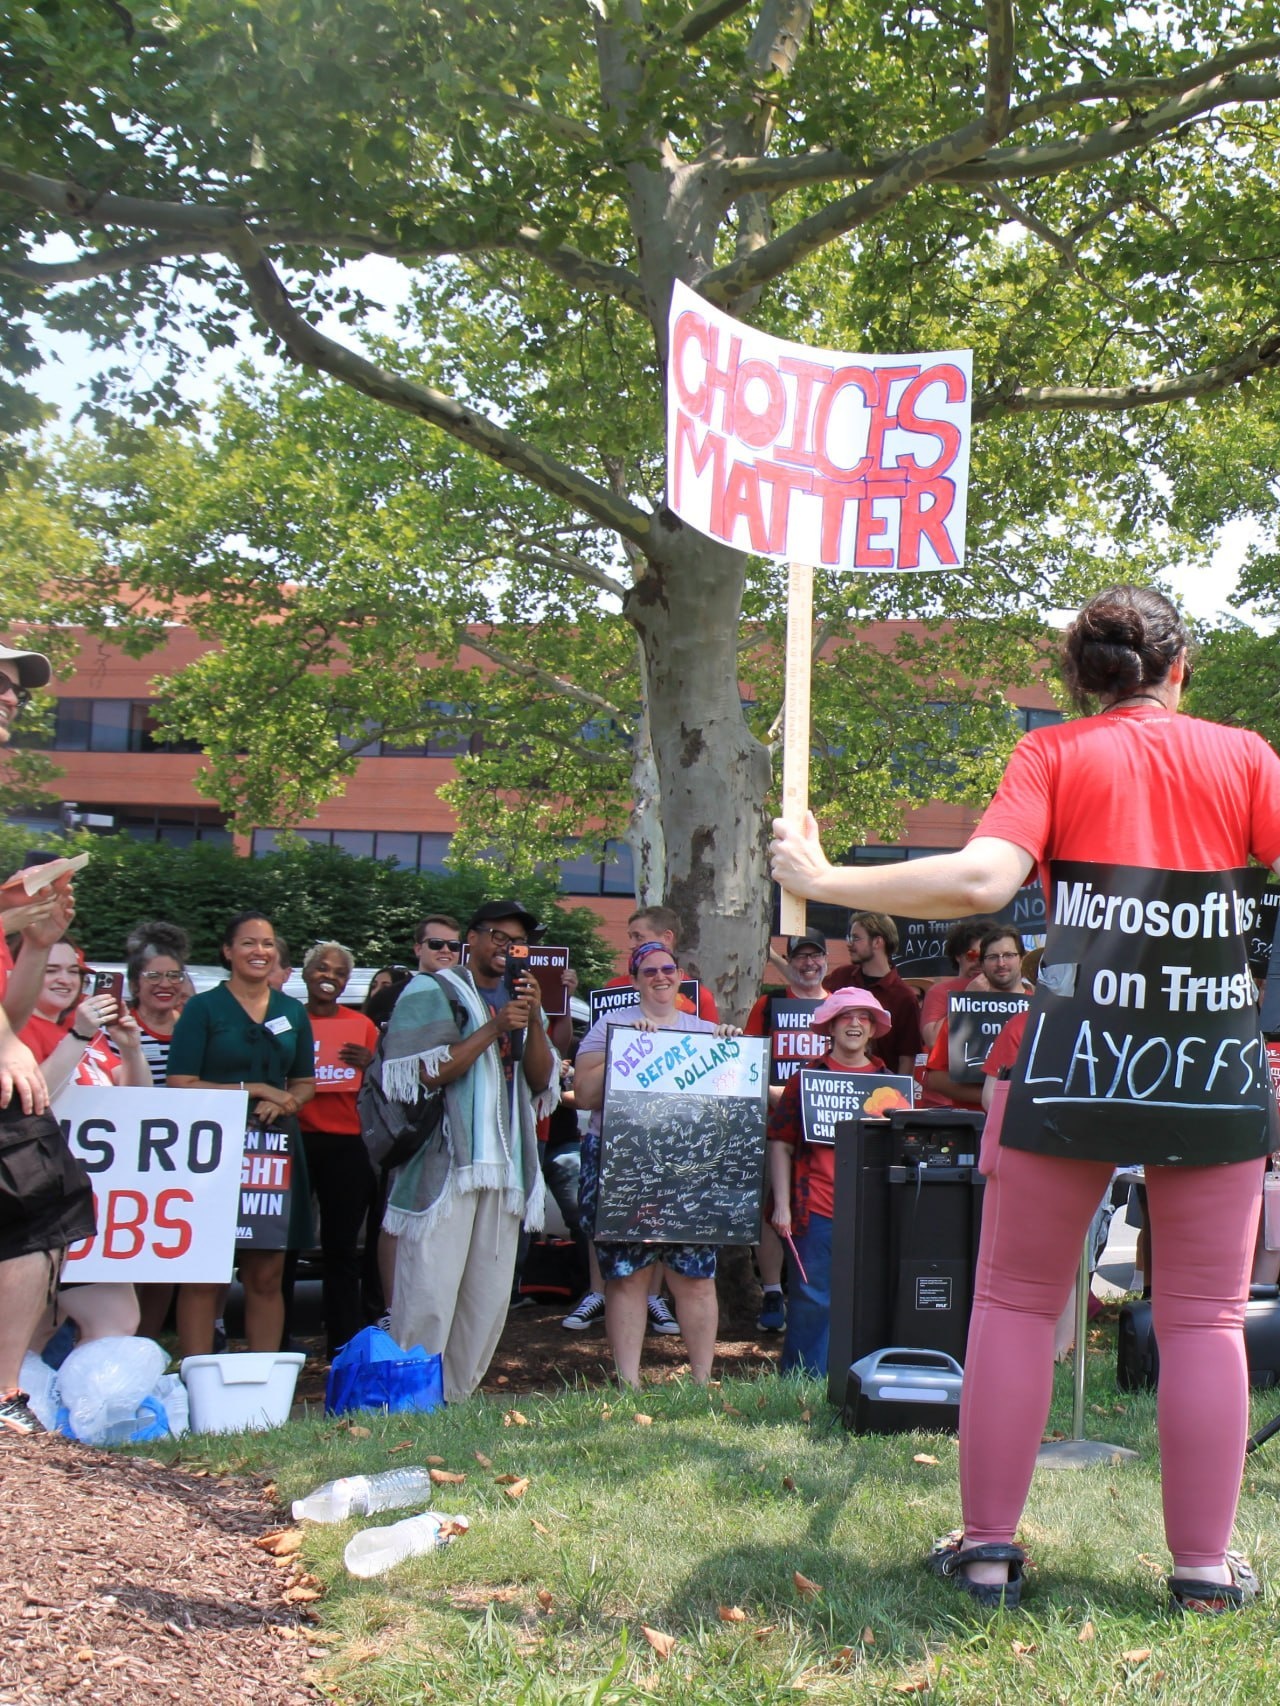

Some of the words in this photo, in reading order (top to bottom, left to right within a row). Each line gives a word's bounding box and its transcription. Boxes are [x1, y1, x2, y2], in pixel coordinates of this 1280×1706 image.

[673, 310, 967, 483] CHOICES
[674, 408, 960, 569] MATTER
[1055, 880, 1229, 939] Microsoft
[908, 922, 925, 935] on
[529, 955, 549, 967] UNS
[551, 956, 565, 967] ON
[1092, 969, 1147, 1010] on
[1160, 963, 1253, 1012] Trust
[594, 991, 641, 1010] LAYOFFS
[951, 997, 1030, 1013] Microsoft
[981, 1022, 1002, 1035] on
[613, 1032, 654, 1077] DEVS
[636, 1035, 698, 1088] BEFORE
[674, 1037, 741, 1090] DOLLARS
[804, 1078, 865, 1095] LAYOFFS...
[811, 1094, 860, 1110] LAYOFFS
[813, 1123, 836, 1138] CHA
[137, 1118, 223, 1174] RO
[265, 1133, 289, 1151] WE
[240, 1156, 288, 1185] GHT
[242, 1192, 284, 1216] WIN
[235, 1226, 253, 1237] WA
